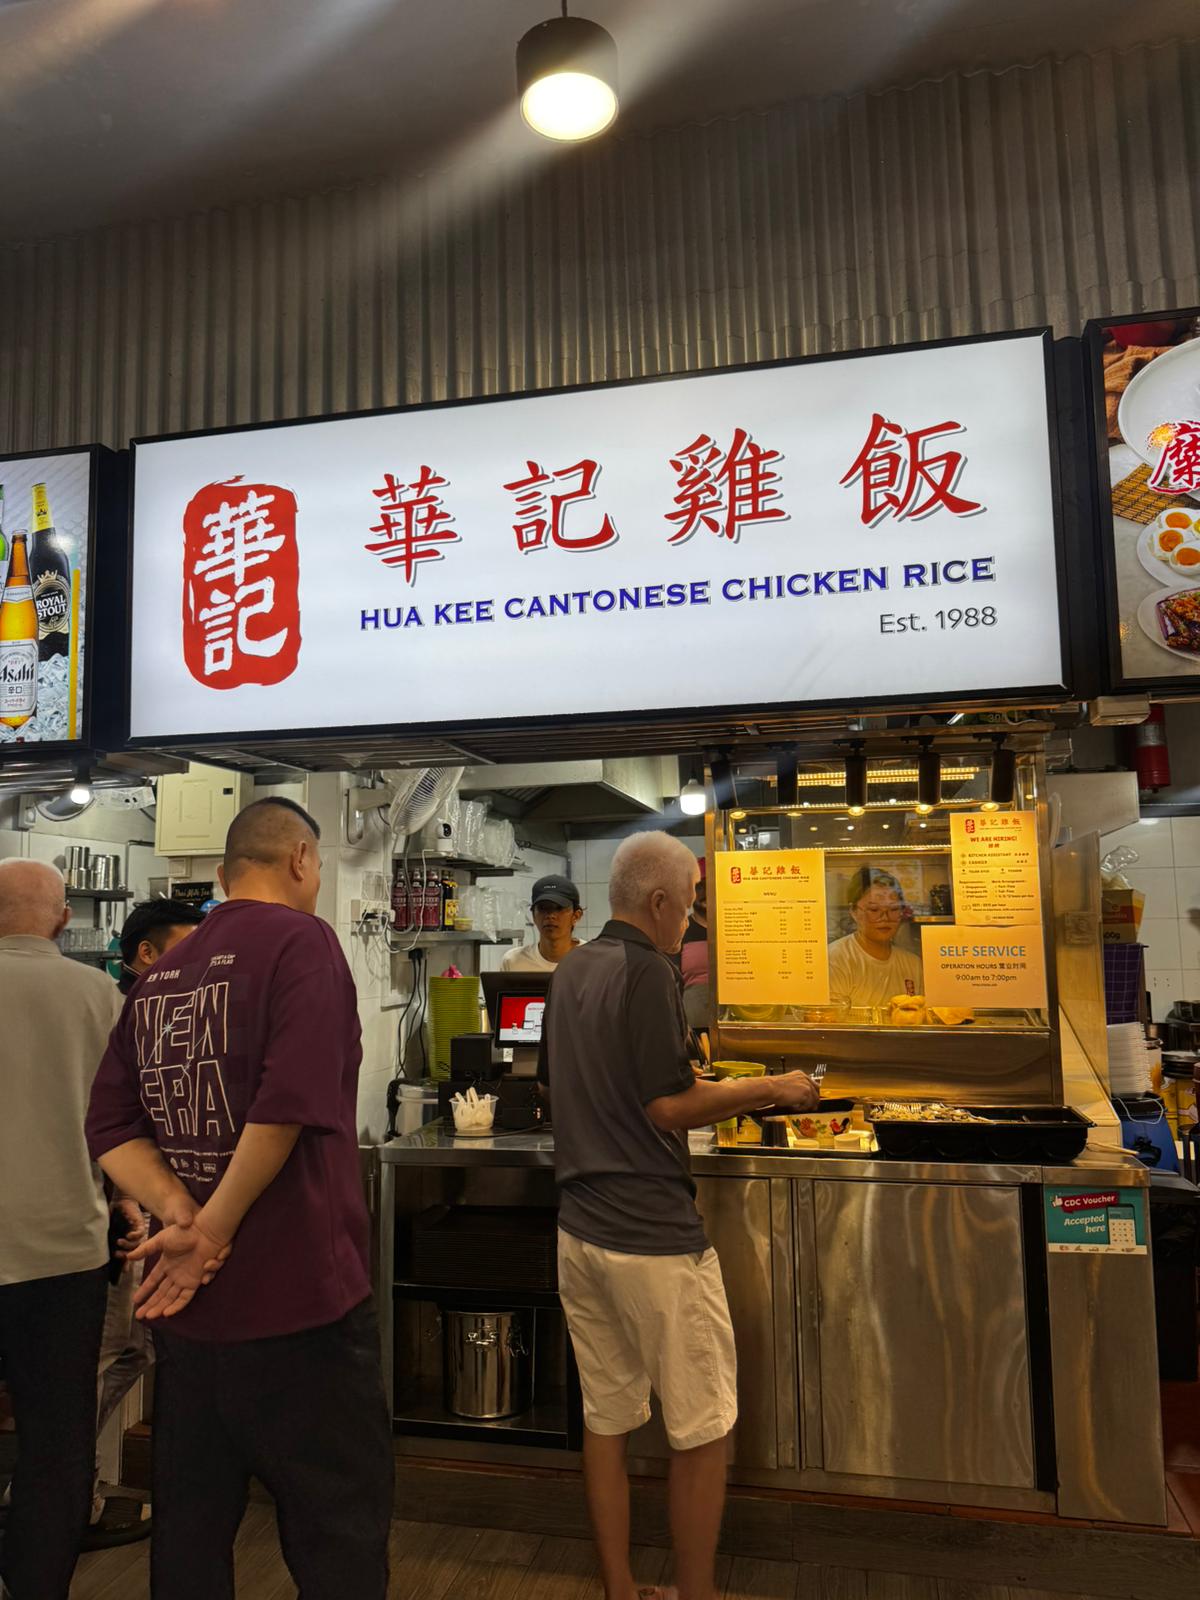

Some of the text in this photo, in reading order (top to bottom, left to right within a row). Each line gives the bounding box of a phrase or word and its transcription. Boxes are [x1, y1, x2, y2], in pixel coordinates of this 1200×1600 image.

[365, 413, 987, 584] 華記雞飯
[194, 490, 288, 676] 華記
[36, 594, 66, 610] ROYAL
[360, 557, 996, 631] HUA KEE CANTONESE CHICKEN RICE
[37, 603, 67, 618] STOUT
[879, 605, 997, 635] Est. 1988
[0, 663, 34, 682] Asahi
[940, 945, 1026, 957] SELF SERVICE
[160, 969, 181, 981] YORK
[991, 974, 1017, 982] 7:00pm
[134, 982, 230, 1067] NEW
[139, 1059, 236, 1137] ERA
[1064, 1195, 1115, 1207] CDC Voucher
[1064, 1214, 1105, 1226] Accepted
[1085, 1224, 1106, 1233] here
